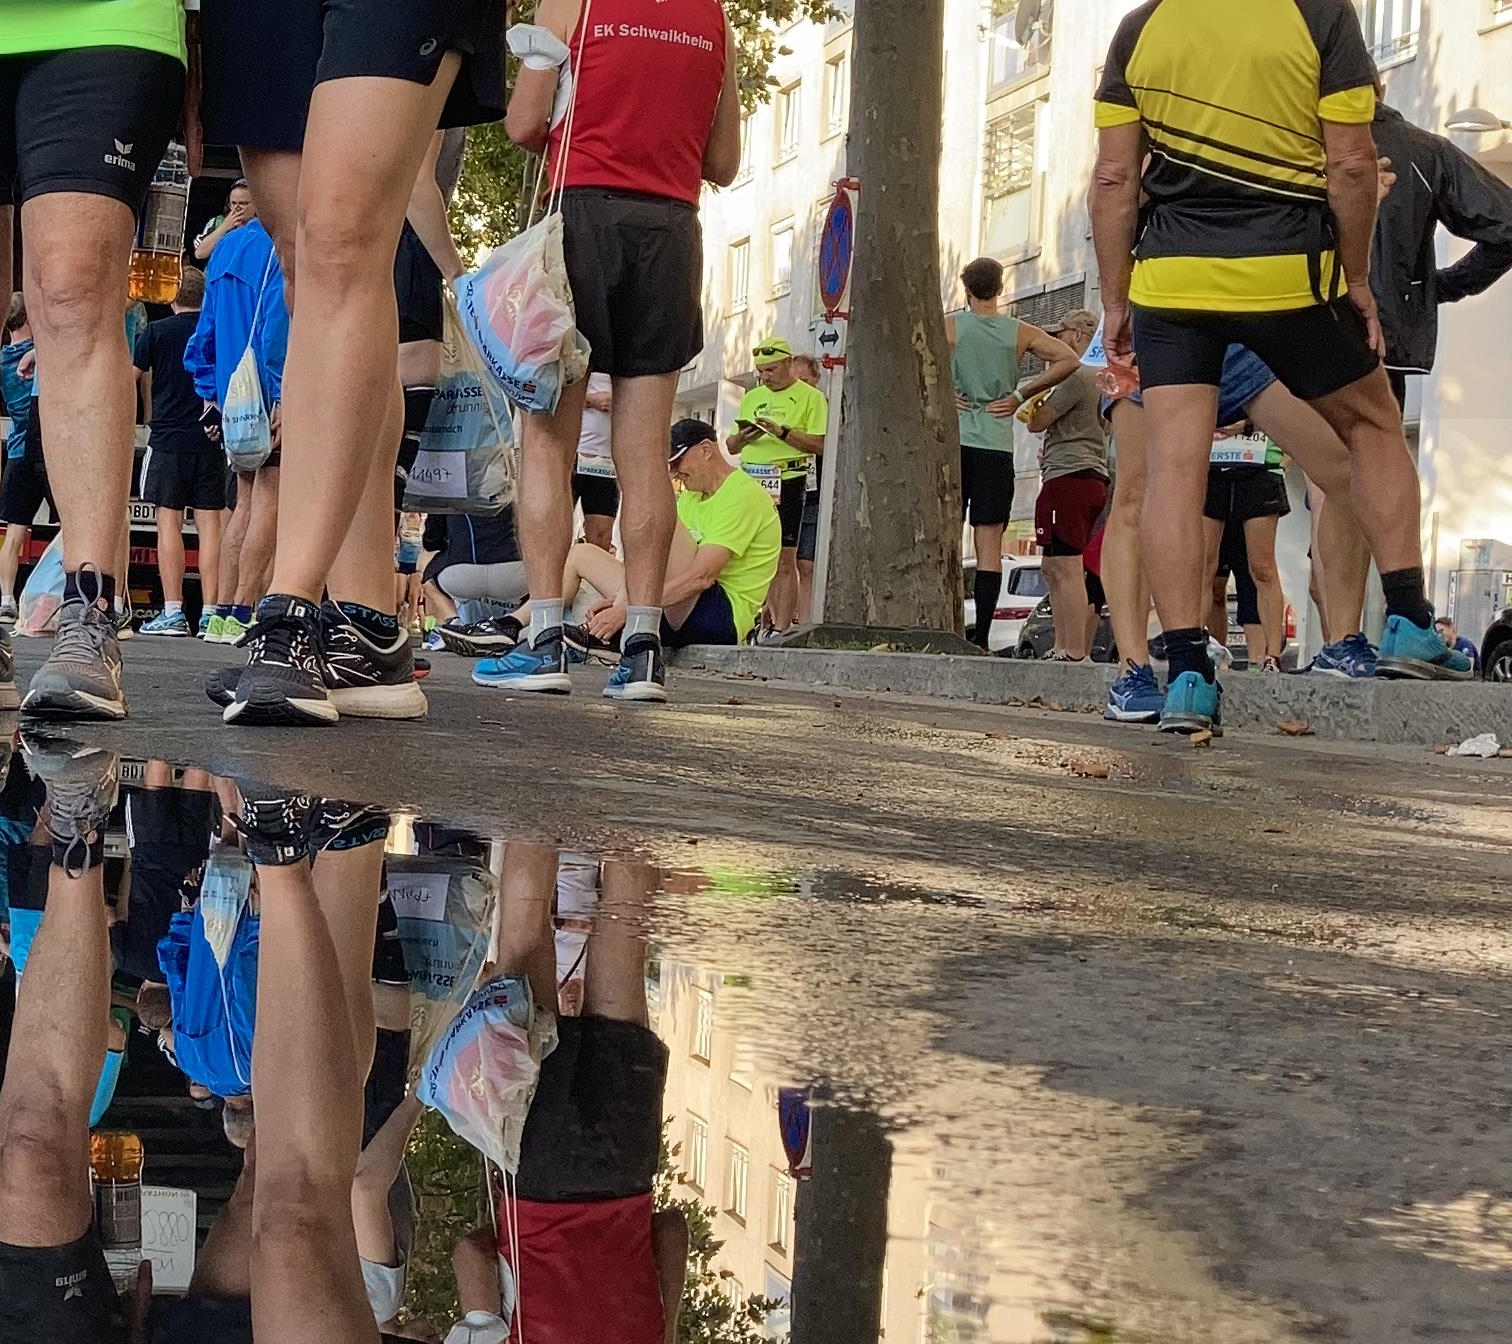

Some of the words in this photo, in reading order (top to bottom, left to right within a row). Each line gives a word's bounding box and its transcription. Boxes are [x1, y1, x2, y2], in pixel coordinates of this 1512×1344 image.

[594, 24, 614, 37] EK
[104, 154, 135, 171] erima
[1211, 452, 1241, 460] ERSTE
